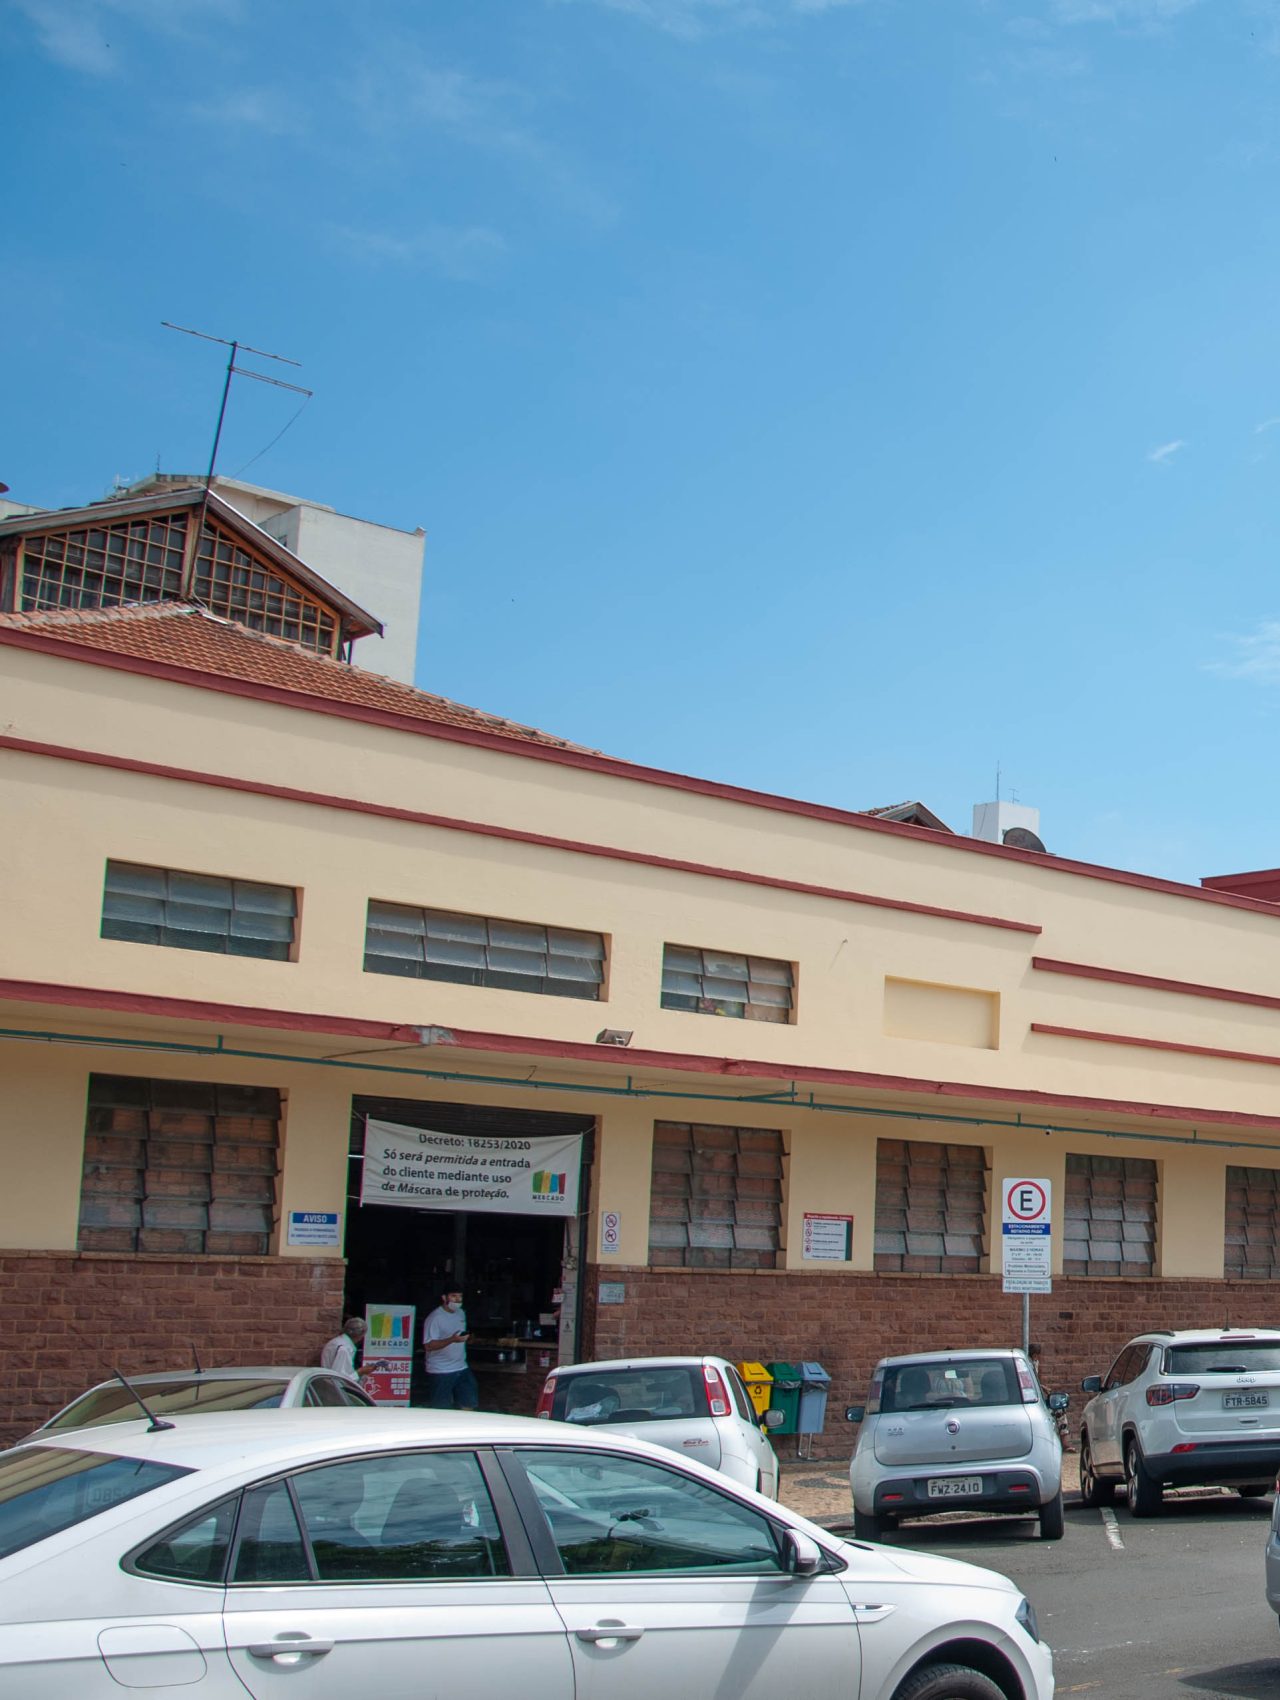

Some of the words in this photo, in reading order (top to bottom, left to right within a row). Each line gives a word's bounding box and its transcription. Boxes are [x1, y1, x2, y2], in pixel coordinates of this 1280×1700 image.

[418, 1133, 464, 1147] Decreto:
[467, 1138, 531, 1150] 18253/2020
[383, 1148, 397, 1160] Só
[399, 1150, 423, 1162] será
[425, 1154, 478, 1166] permitida
[480, 1158, 487, 1166] a
[489, 1157, 531, 1169] entrada
[383, 1165, 397, 1177] do
[399, 1168, 435, 1180] cliente
[437, 1170, 489, 1183] mediante
[492, 1174, 512, 1184] uso
[381, 1181, 395, 1193] de
[397, 1182, 442, 1197] Máscara
[445, 1186, 459, 1197] de
[461, 1187, 510, 1200] proteção.
[532, 1194, 565, 1202] MERCADO
[1020, 1190, 1033, 1211] E
[303, 1214, 327, 1223] AVISO
